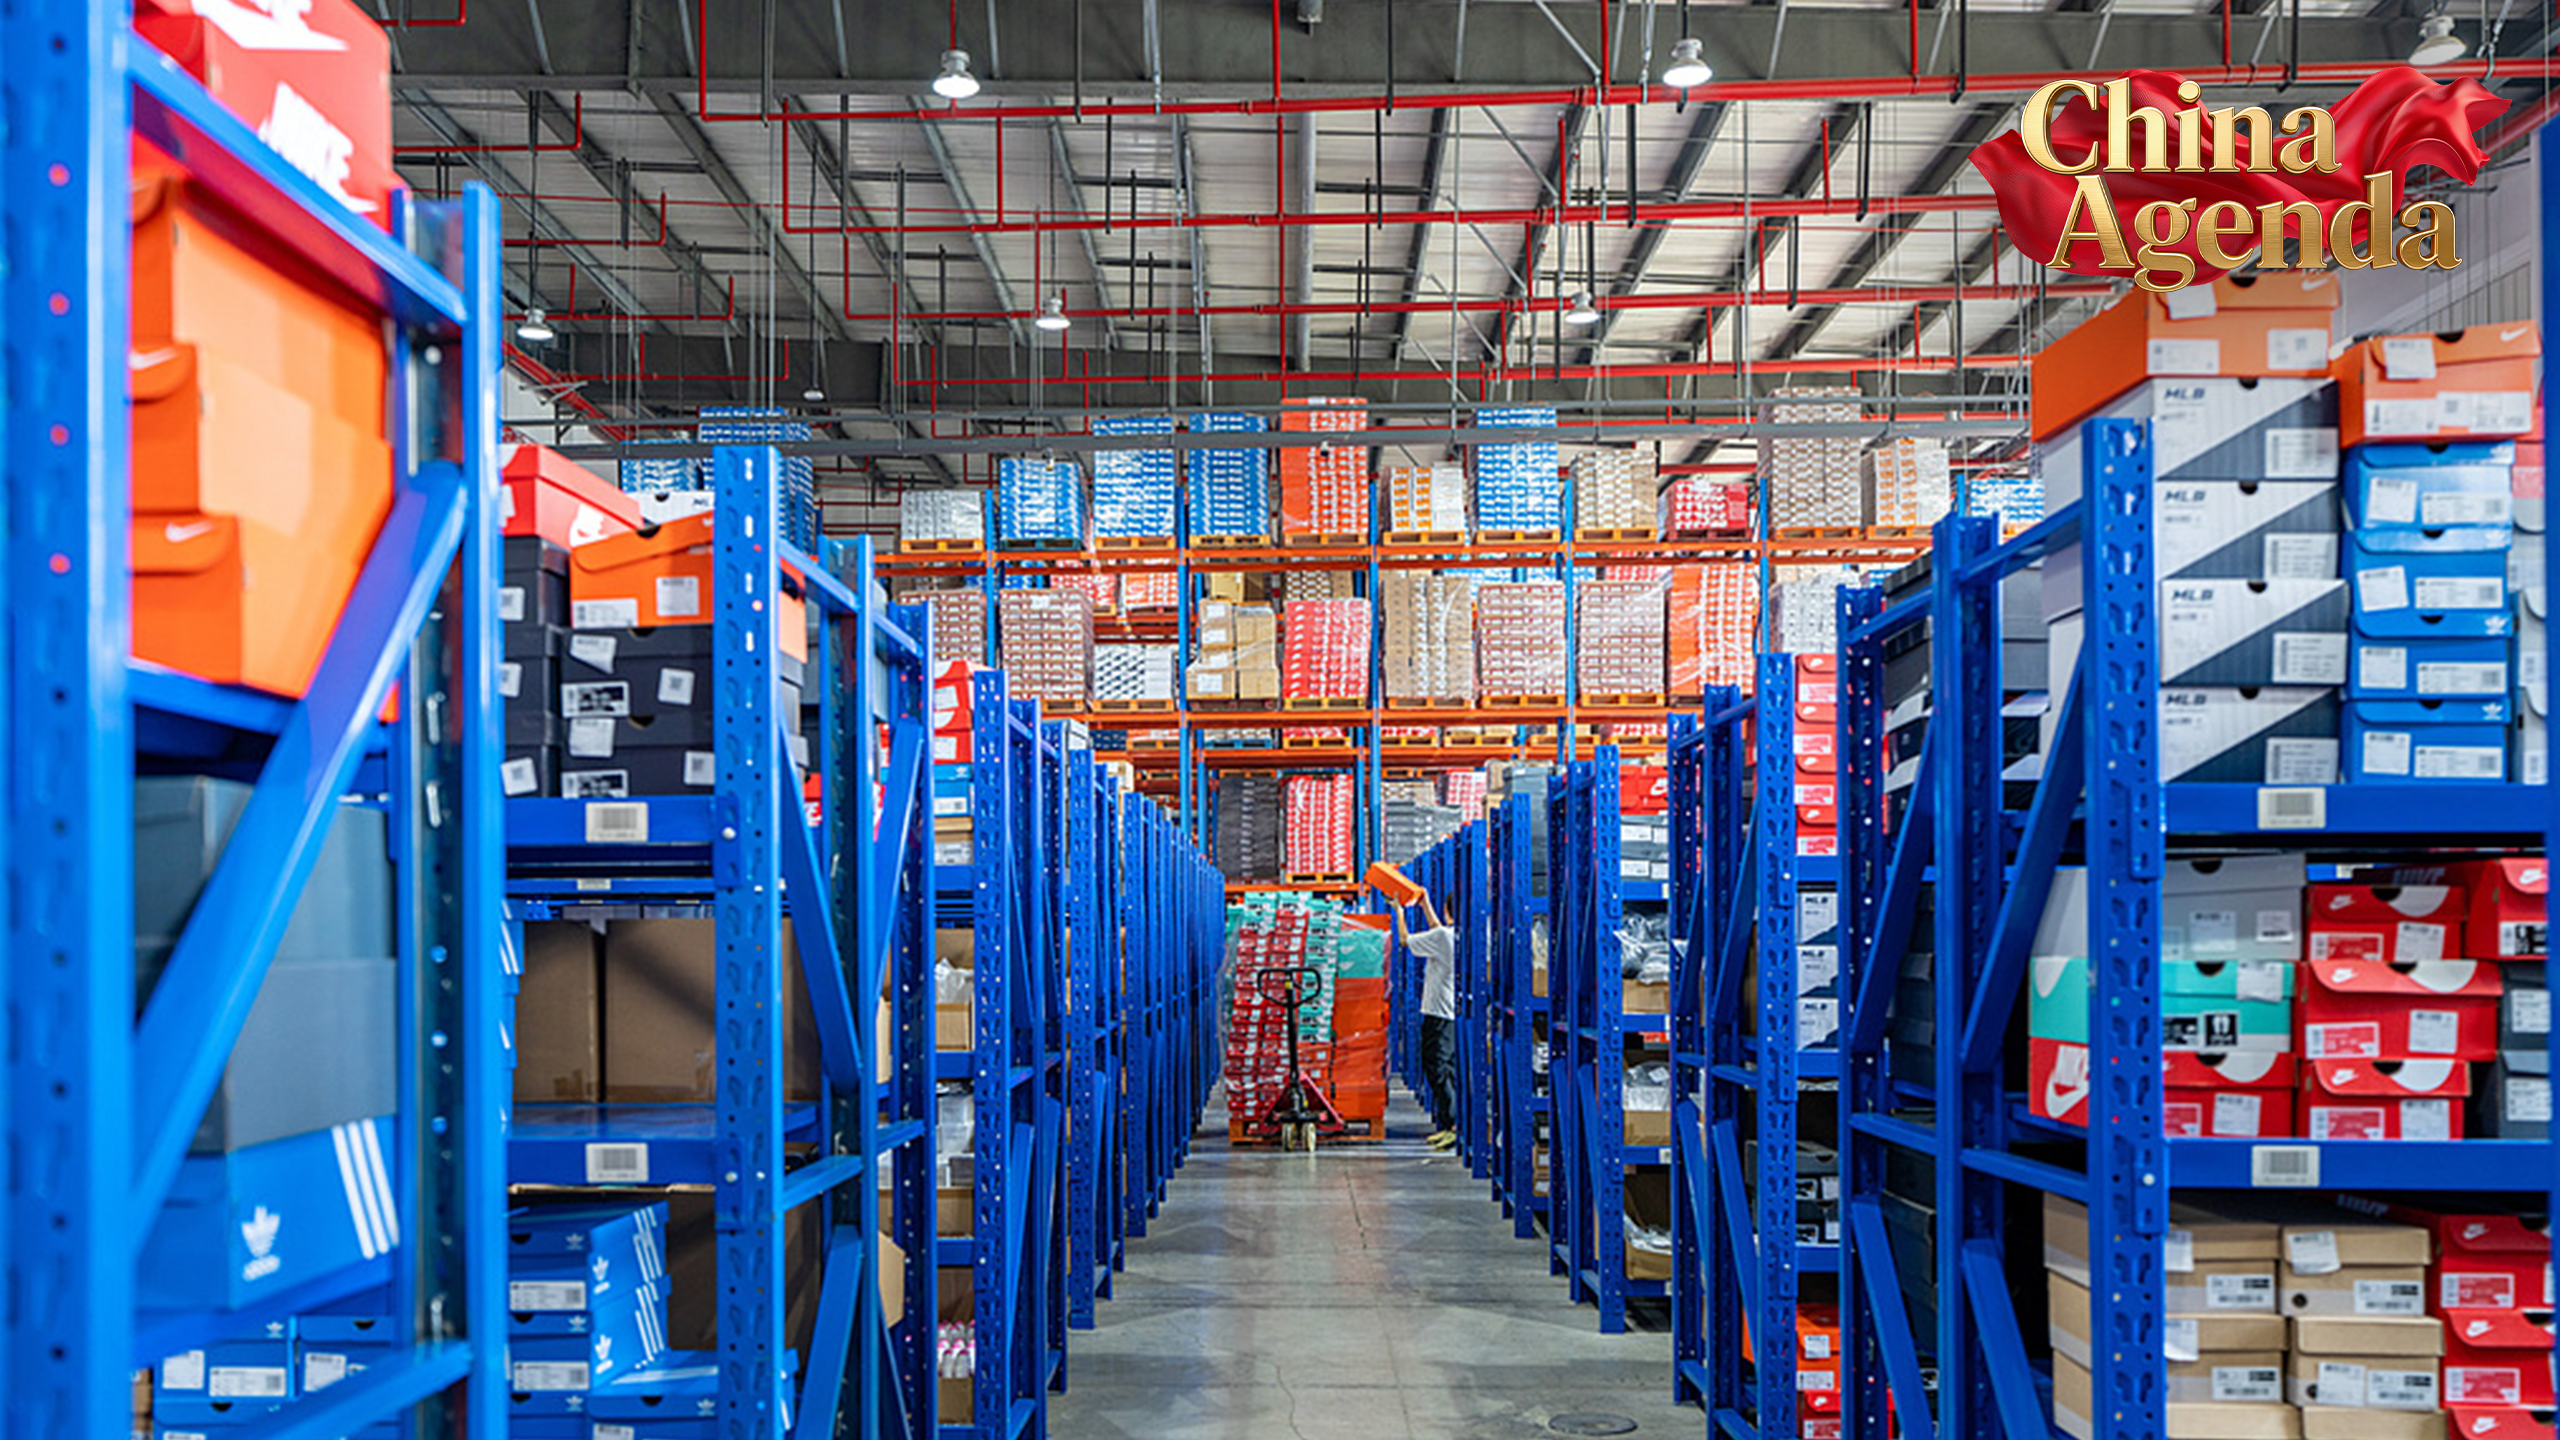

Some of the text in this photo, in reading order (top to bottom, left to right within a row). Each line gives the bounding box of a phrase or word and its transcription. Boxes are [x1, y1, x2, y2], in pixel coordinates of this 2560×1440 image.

[2164, 387, 2206, 400] MLB
[2164, 490, 2206, 502] MLB
[2171, 589, 2214, 601] MLB
[2165, 693, 2207, 705] MLB
